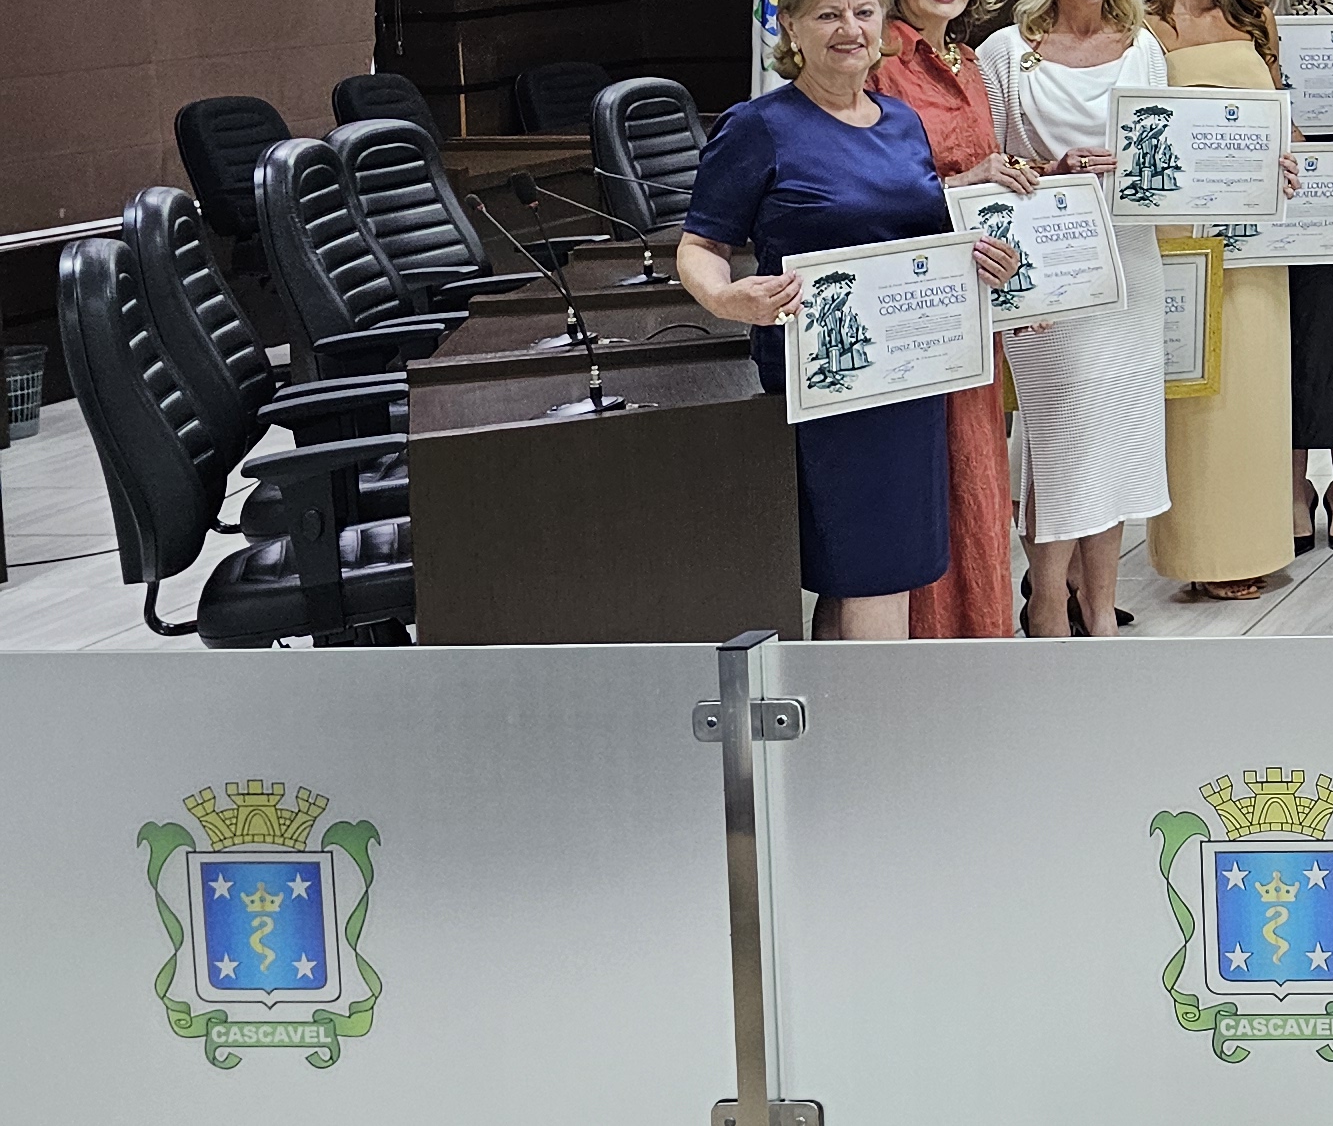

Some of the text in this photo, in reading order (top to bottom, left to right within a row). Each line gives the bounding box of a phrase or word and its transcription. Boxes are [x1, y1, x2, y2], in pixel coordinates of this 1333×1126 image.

[1191, 133, 1213, 141] VOTO
[1216, 133, 1226, 141] DE
[1229, 133, 1262, 142] LOUVOR
[1191, 141, 1269, 151] CONGRATULAÇÕES
[1032, 219, 1097, 234] VOTO DE LOUVOR E
[1035, 229, 1098, 244] CONGRATULAÇÕES
[877, 283, 967, 305] VOTO DE LOUVOR E
[879, 294, 967, 316] CONGRATULAÇÕES
[212, 1026, 332, 1043] CASCAVEL
